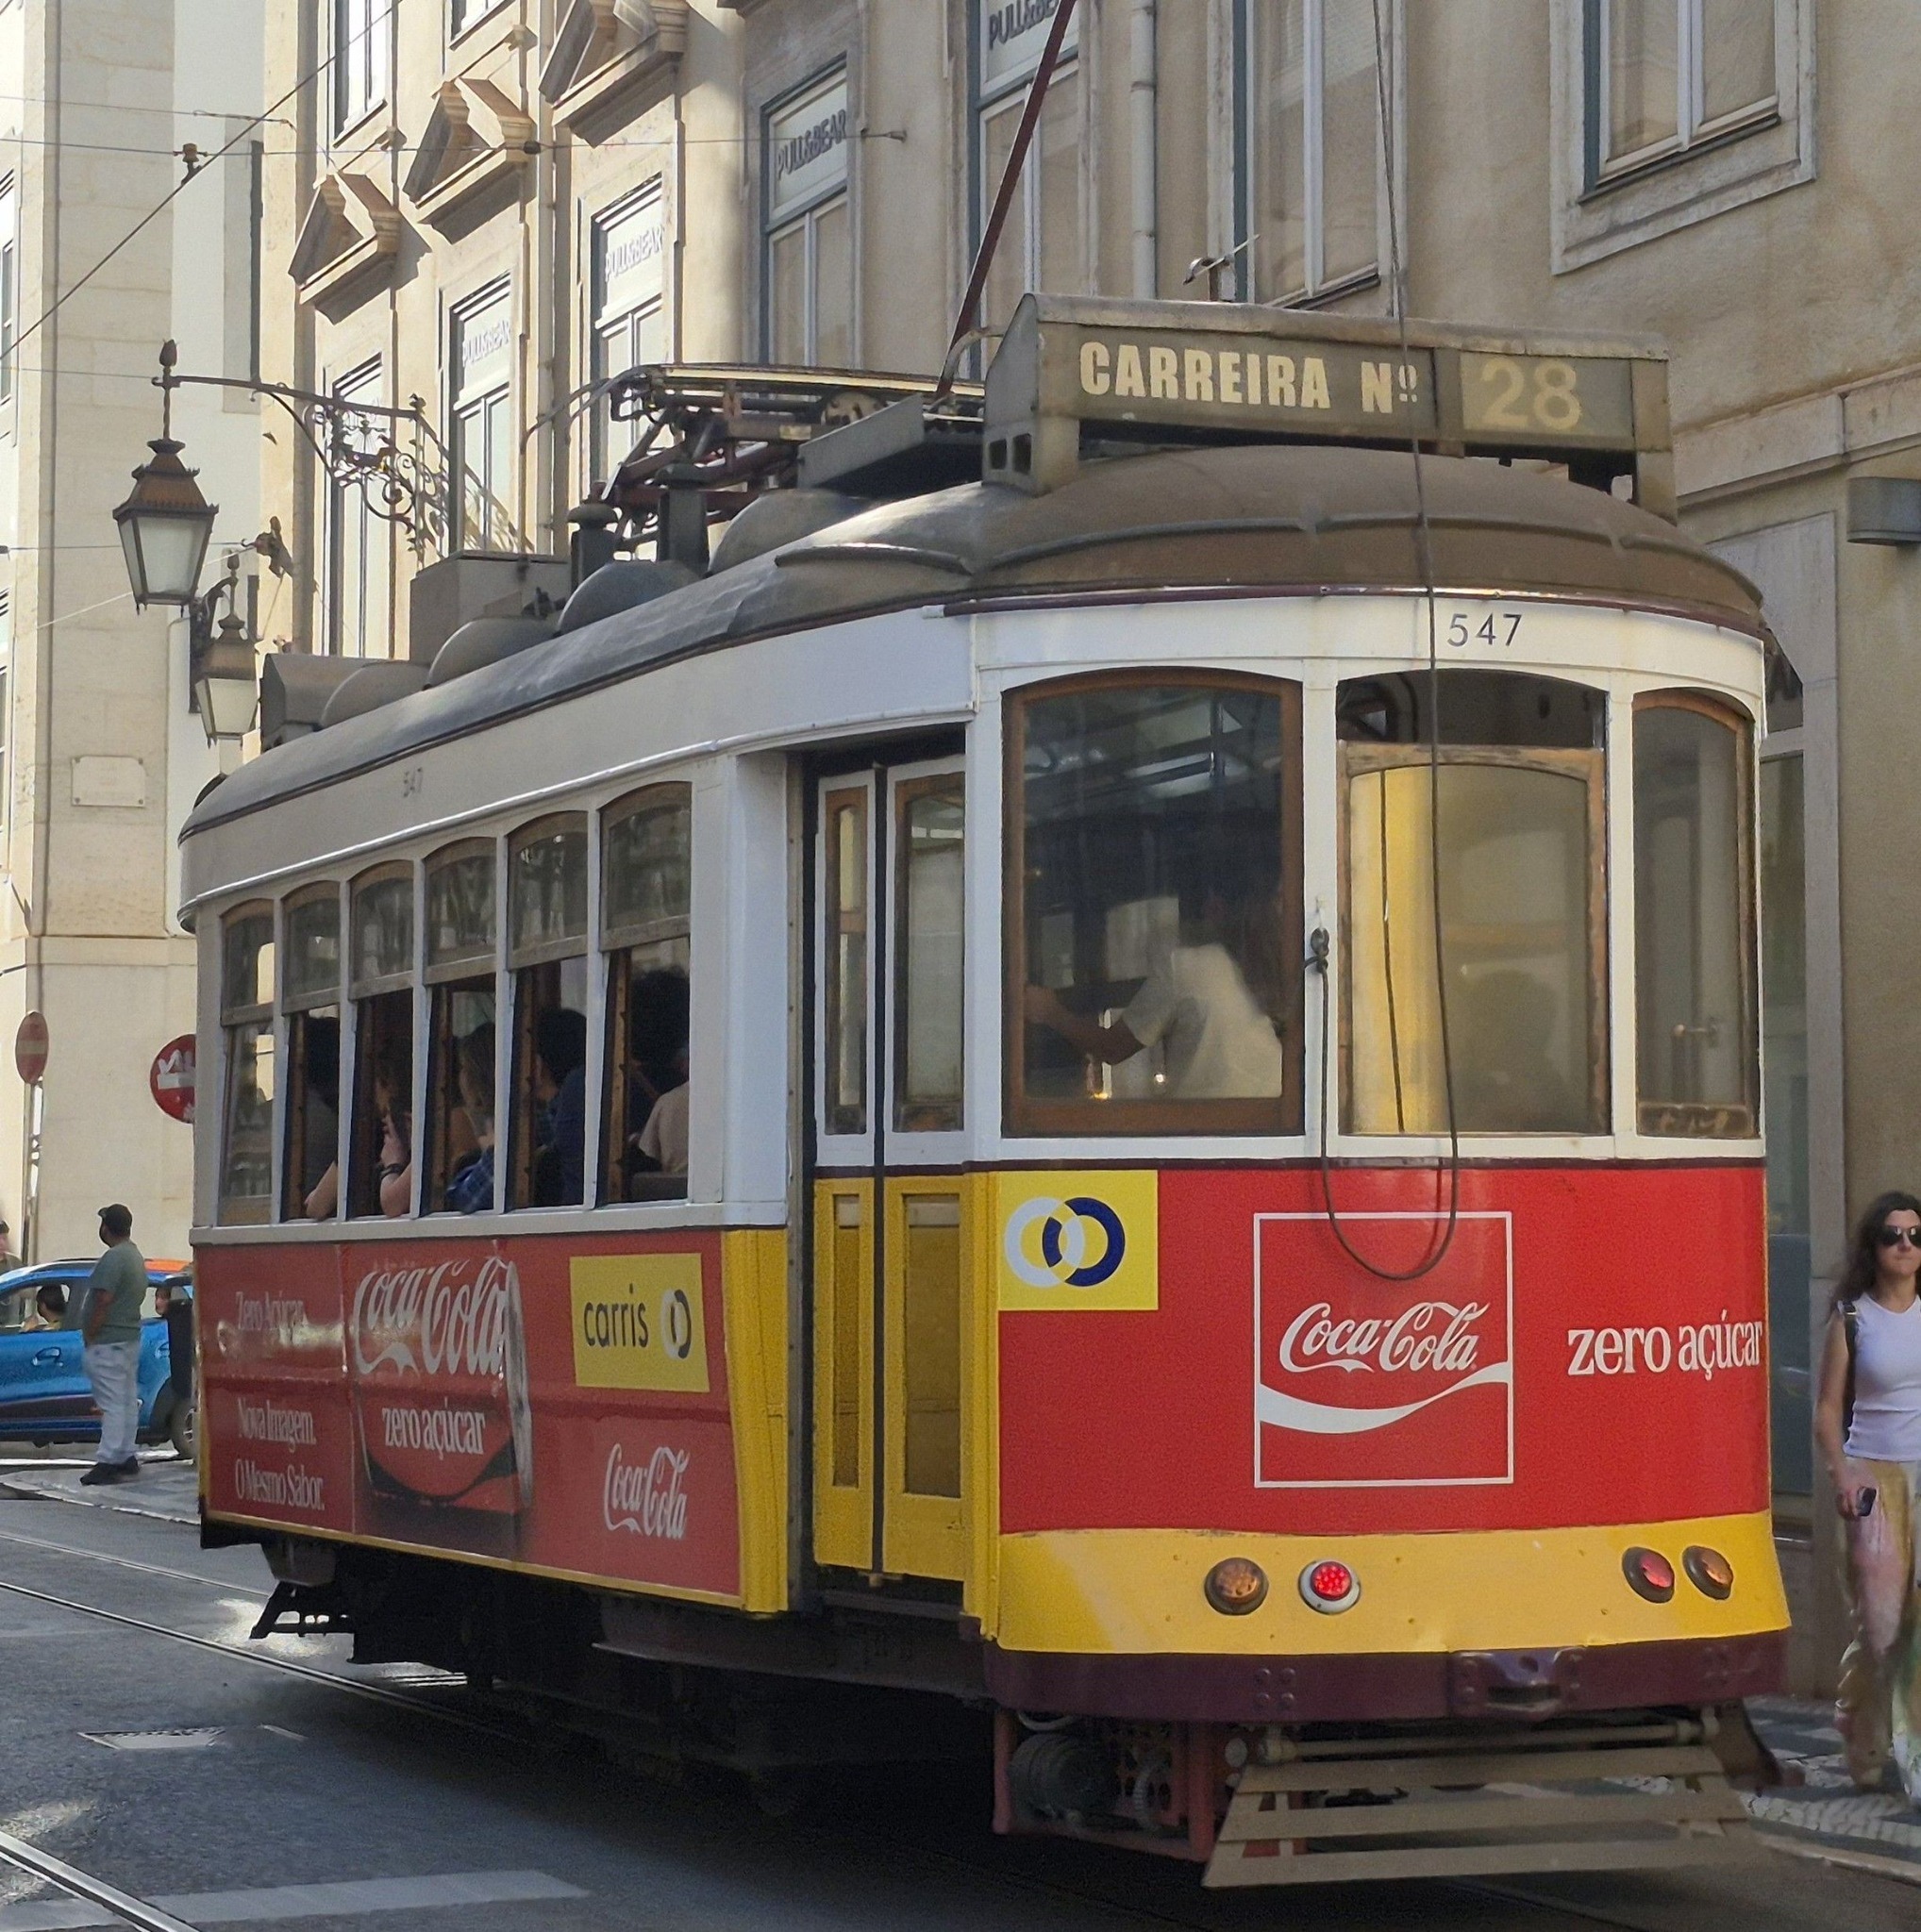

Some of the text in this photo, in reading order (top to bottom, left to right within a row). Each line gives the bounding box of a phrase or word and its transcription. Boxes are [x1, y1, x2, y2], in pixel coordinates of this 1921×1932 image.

[776, 108, 846, 181] PULL&BEAR
[1079, 341, 1331, 409] CARREIRA
[1479, 357, 1582, 430] 28
[1446, 612, 1522, 647] 547
[353, 1257, 509, 1375] Coca-Cola
[583, 1282, 650, 1348] carris
[1279, 1302, 1491, 1374] Coca-Cola
[1567, 1308, 1762, 1381] zero açúcar
[381, 1396, 486, 1460] zero açúcar
[287, 1463, 326, 1511] Sabor.
[604, 1443, 691, 1540] Coca-Cola
